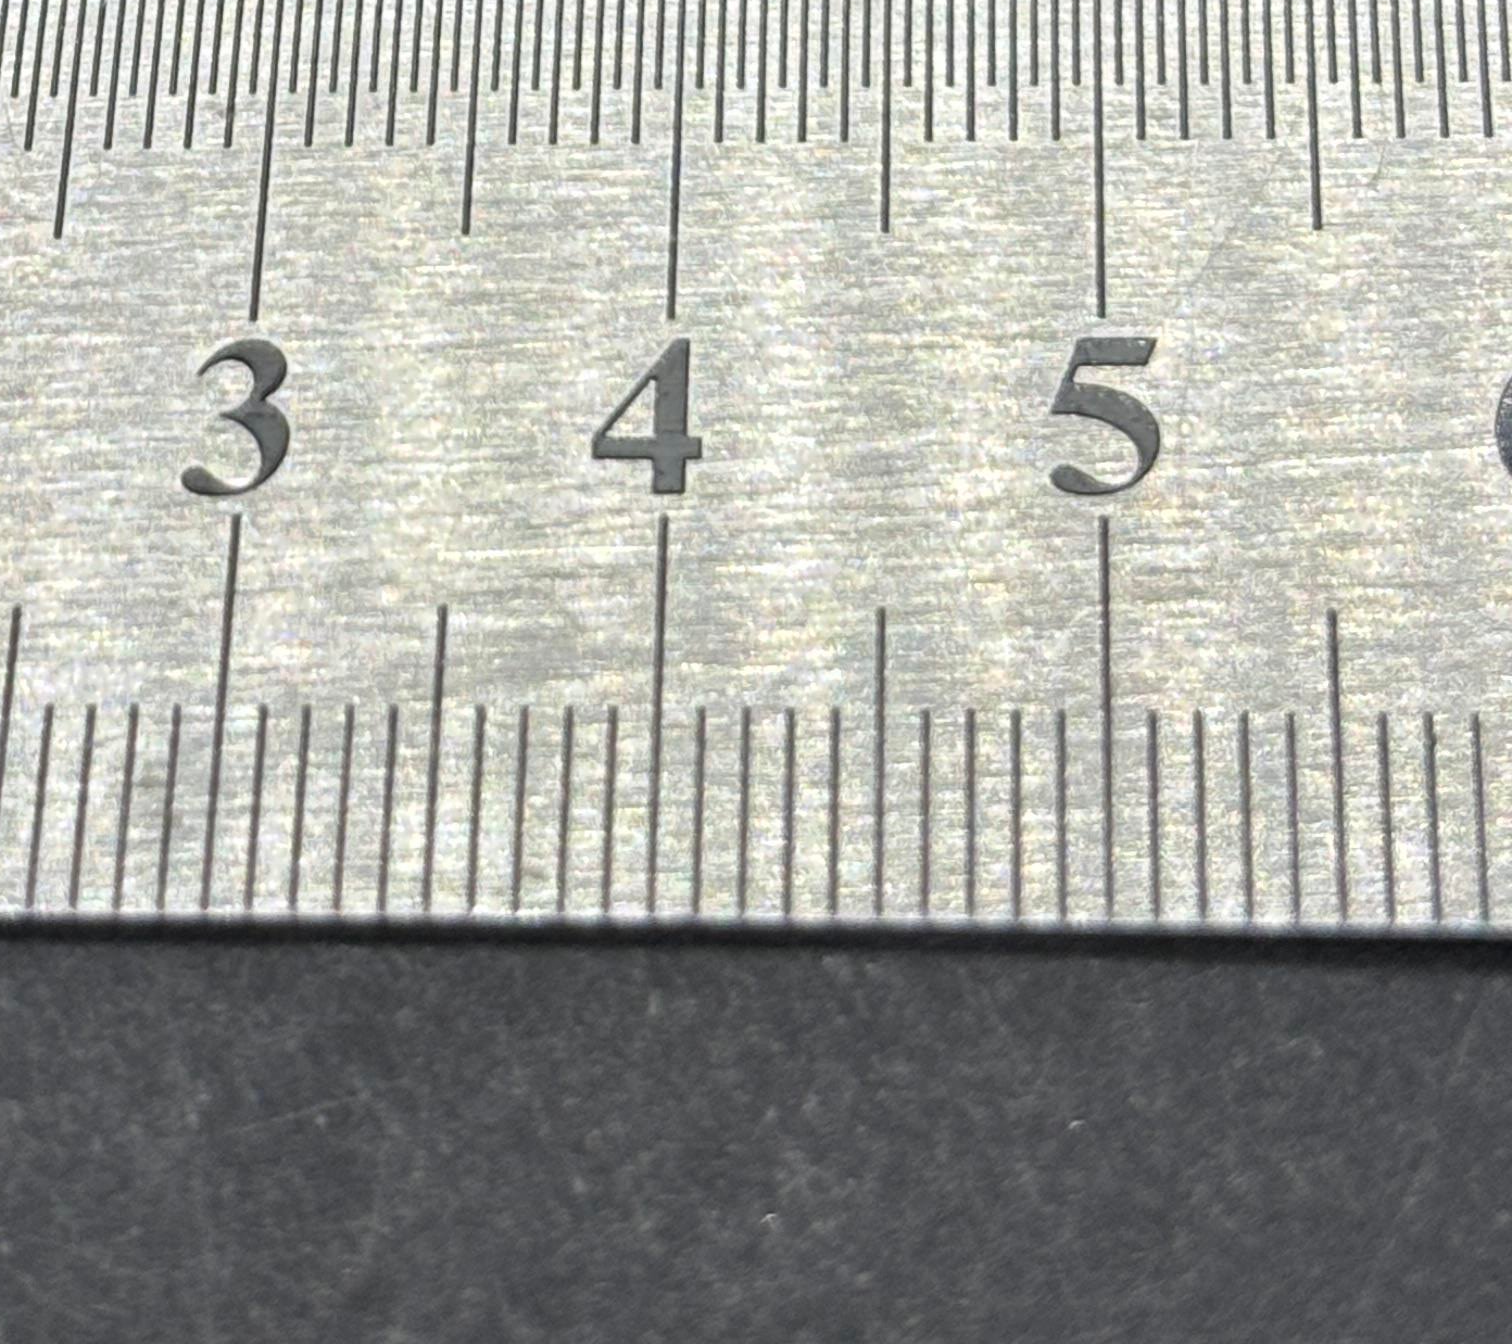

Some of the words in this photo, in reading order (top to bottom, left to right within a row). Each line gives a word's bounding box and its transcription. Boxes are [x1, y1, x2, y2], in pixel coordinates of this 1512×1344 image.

[180, 338, 291, 497] 3
[591, 337, 703, 495] 4
[1049, 336, 1162, 497] 5
